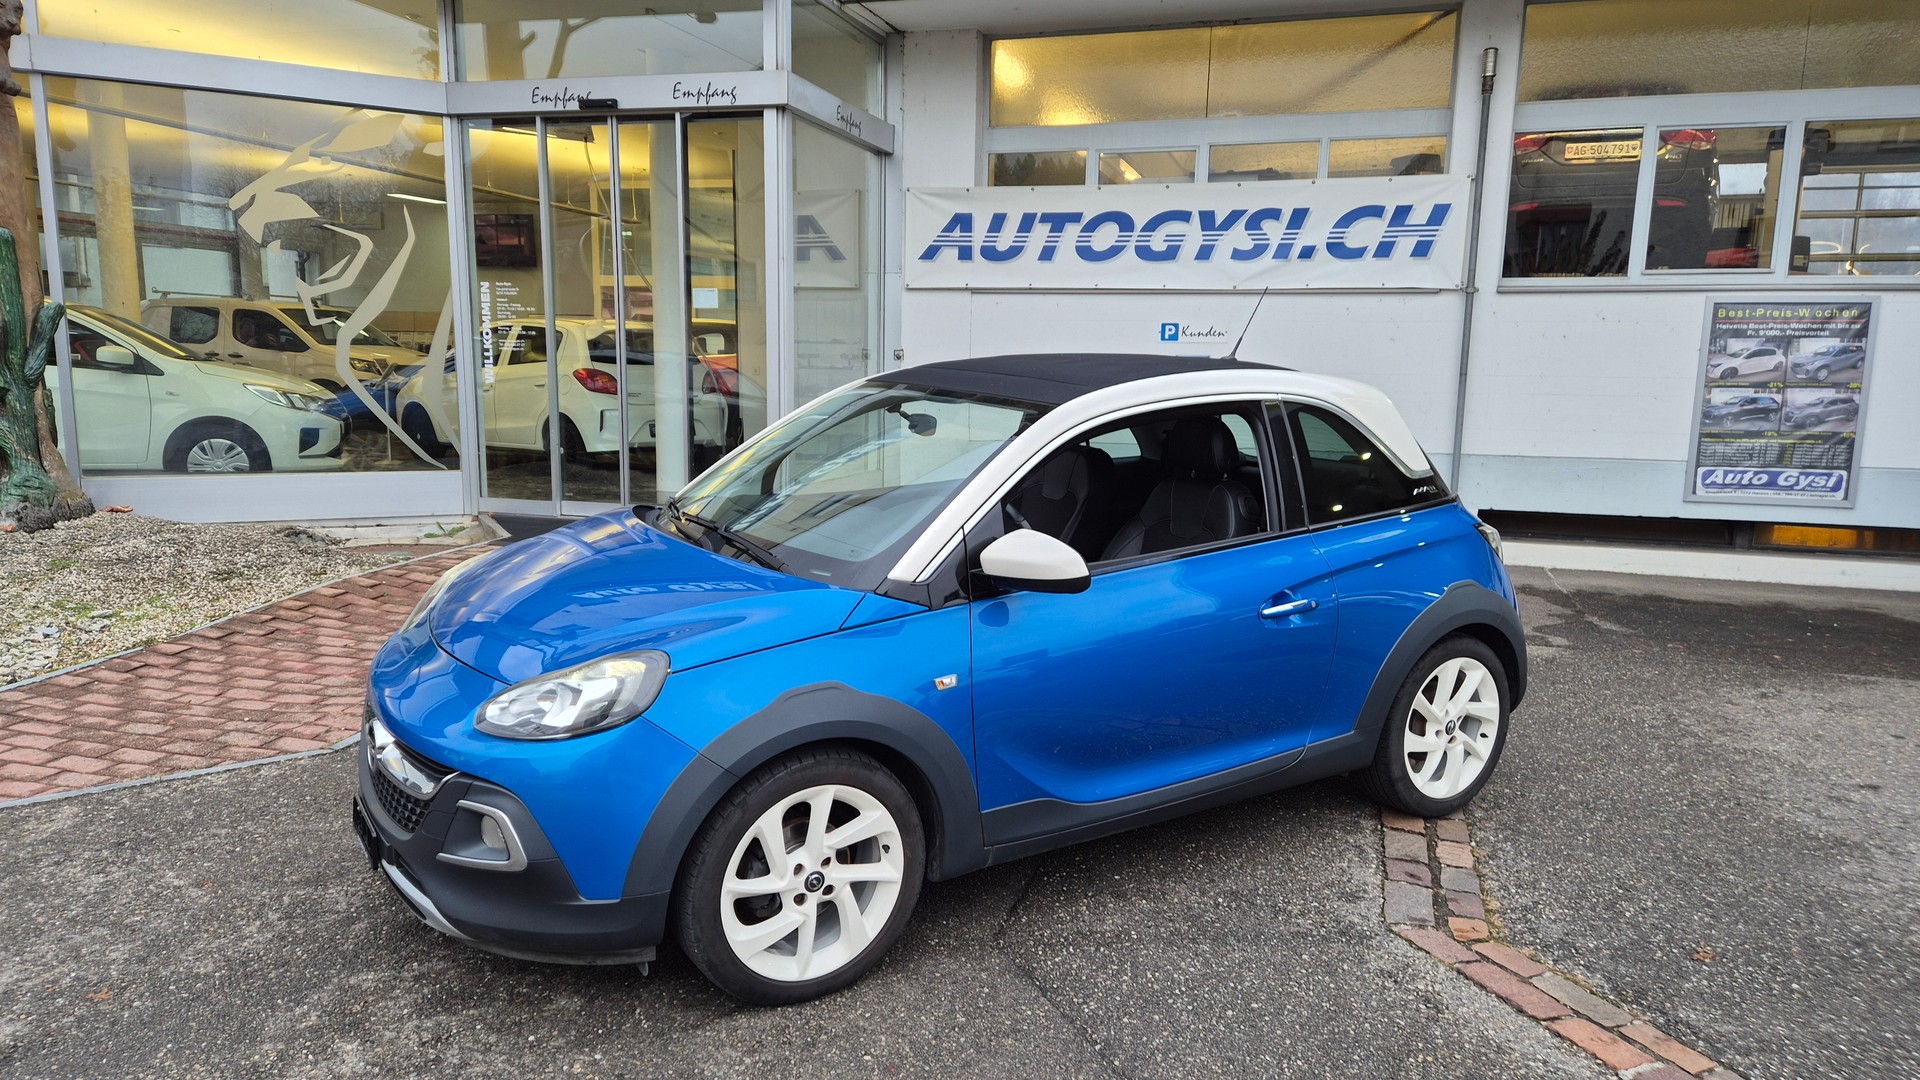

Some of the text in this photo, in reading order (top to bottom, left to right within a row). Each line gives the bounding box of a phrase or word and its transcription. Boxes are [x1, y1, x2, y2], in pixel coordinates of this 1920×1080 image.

[672, 81, 737, 104] Empfang
[836, 104, 862, 137] Empfang
[917, 202, 1454, 263] AUTOGYSI.CH
[480, 281, 494, 384] WILLKOMMEN
[1181, 324, 1226, 337] Kunden
[1704, 470, 1839, 490] Auto Gysi
